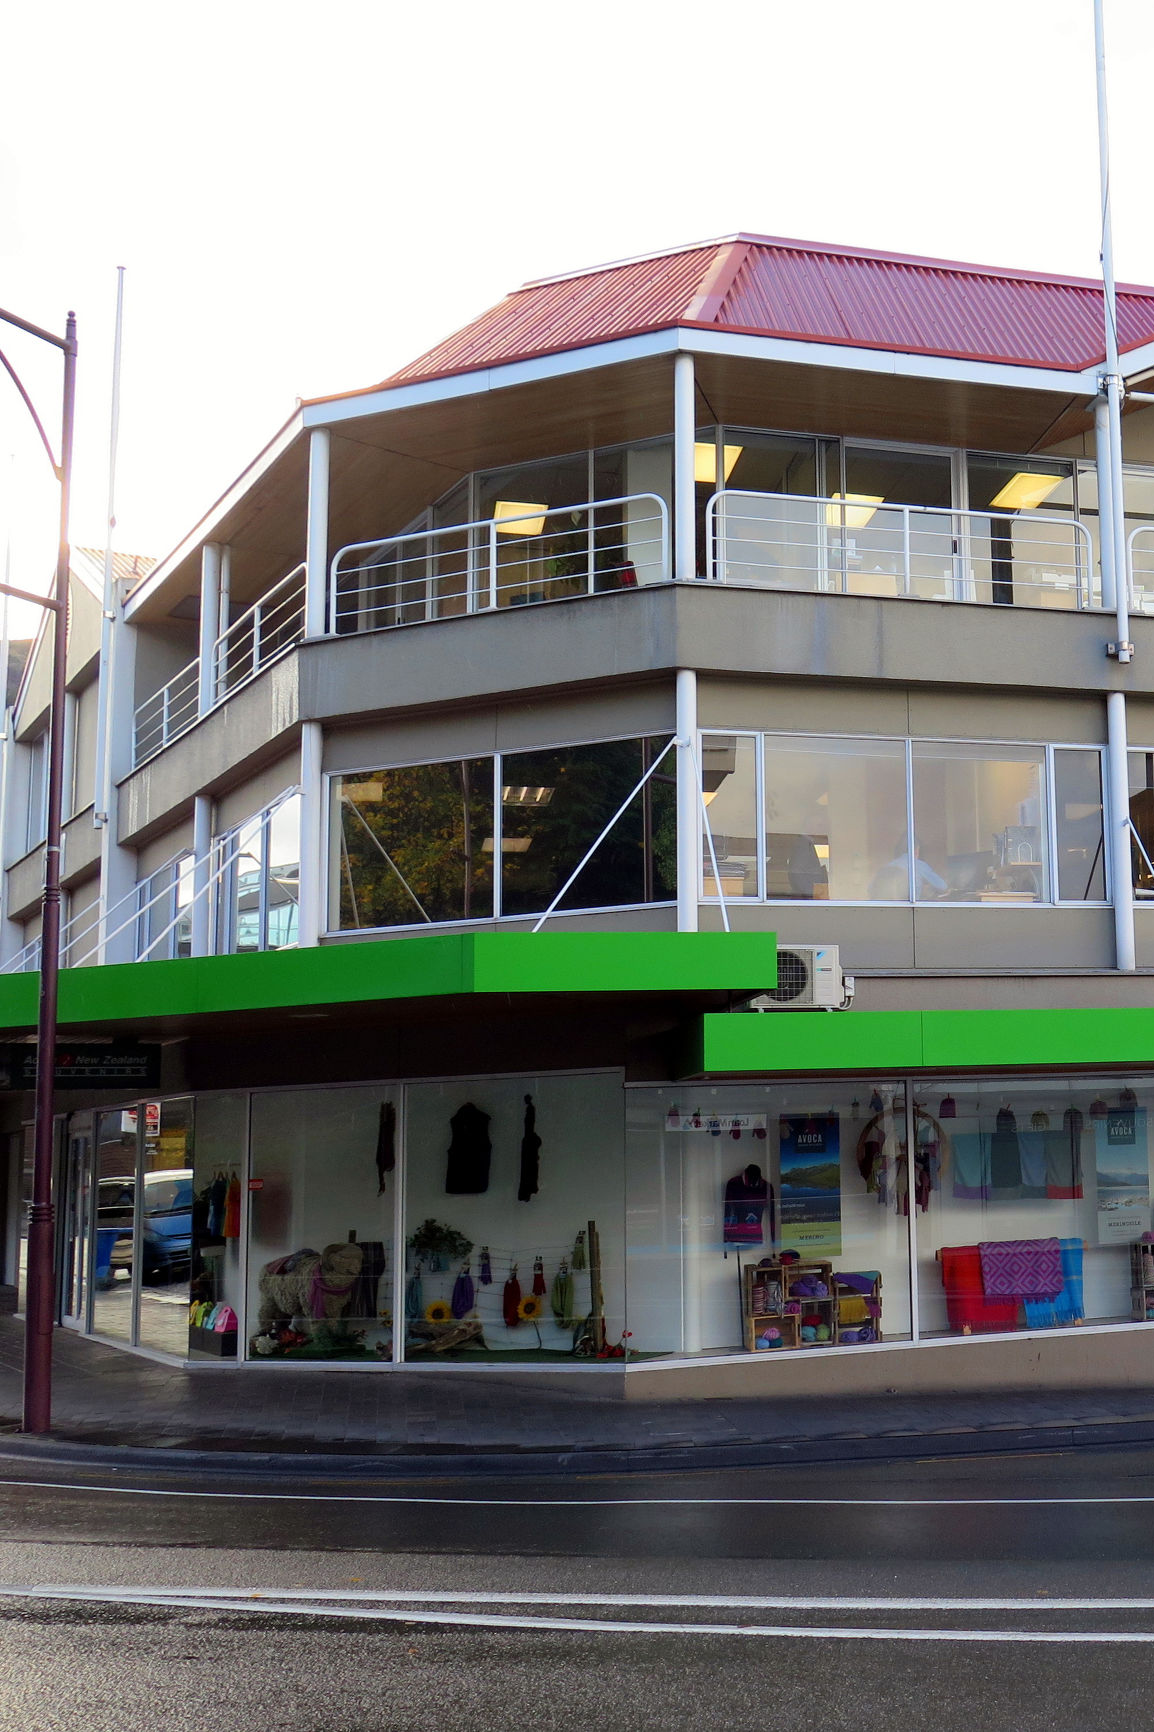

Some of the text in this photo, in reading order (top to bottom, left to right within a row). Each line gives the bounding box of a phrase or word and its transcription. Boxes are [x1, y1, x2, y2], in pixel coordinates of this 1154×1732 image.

[75, 1055, 148, 1065] New Zealand
[24, 1067, 147, 1075] SUVENIRS
[1110, 1126, 1133, 1136] AVOCA
[797, 1134, 823, 1144] AVOCA
